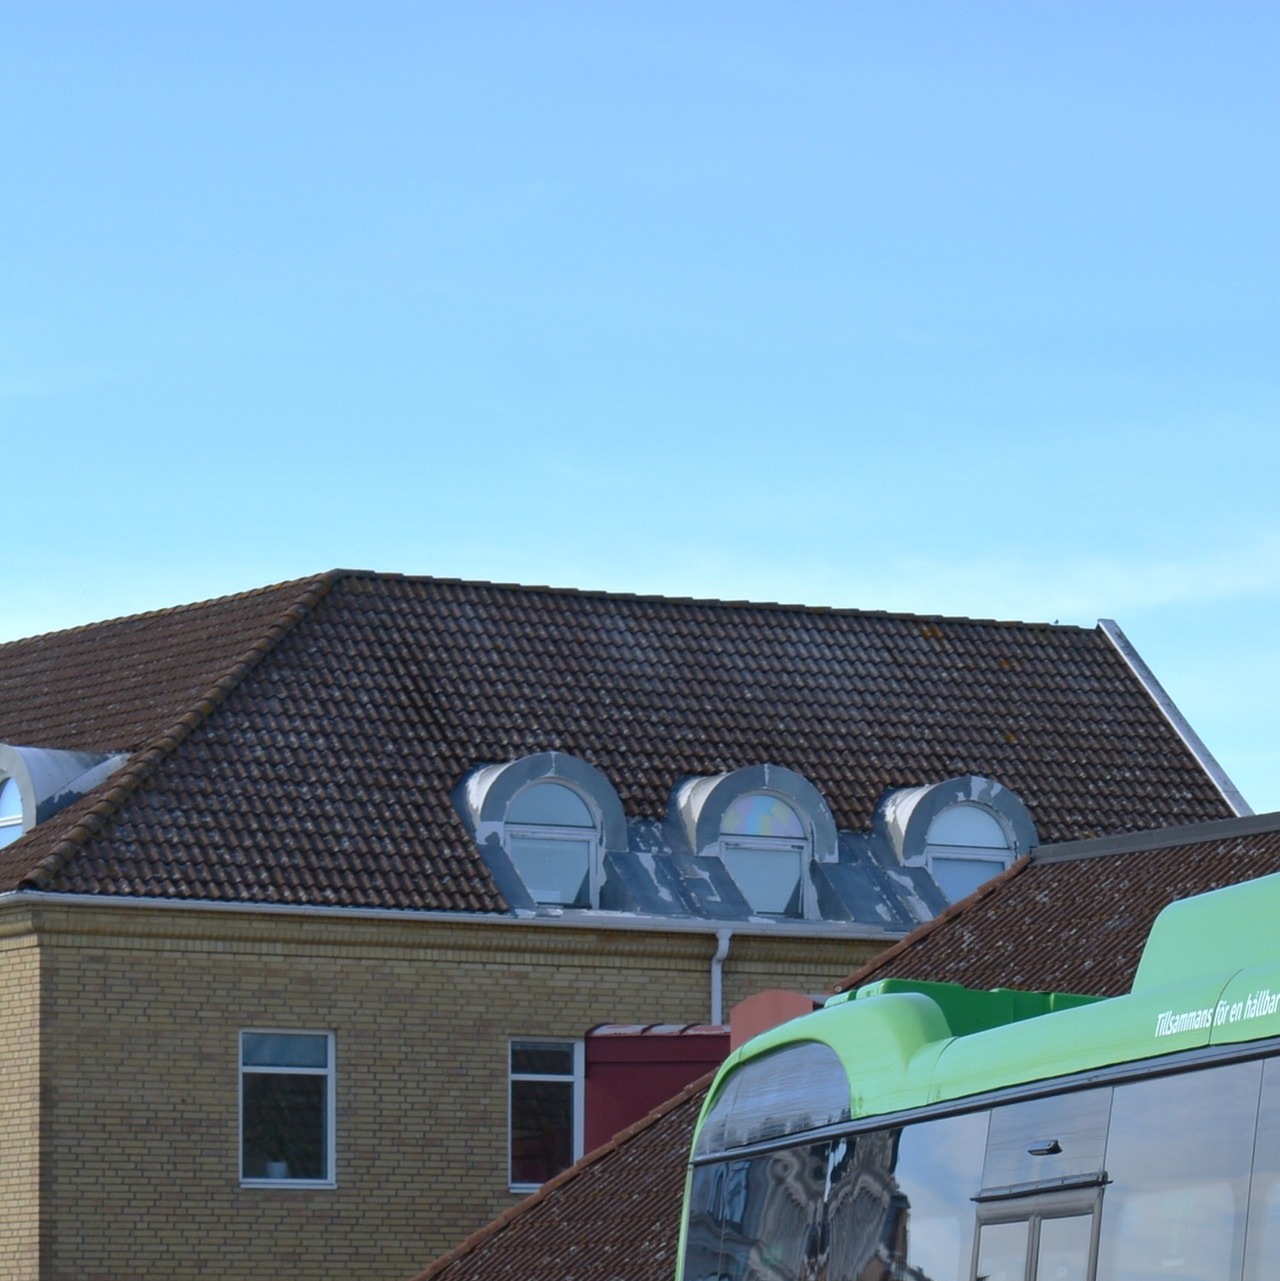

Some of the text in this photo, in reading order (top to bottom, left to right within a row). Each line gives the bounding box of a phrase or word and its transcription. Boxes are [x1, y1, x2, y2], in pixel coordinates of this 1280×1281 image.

[1155, 1008, 1214, 1037] Tillsammans
[1212, 1000, 1230, 1027] för
[1229, 1001, 1244, 1023] en
[1243, 988, 1280, 1019] hållbar
